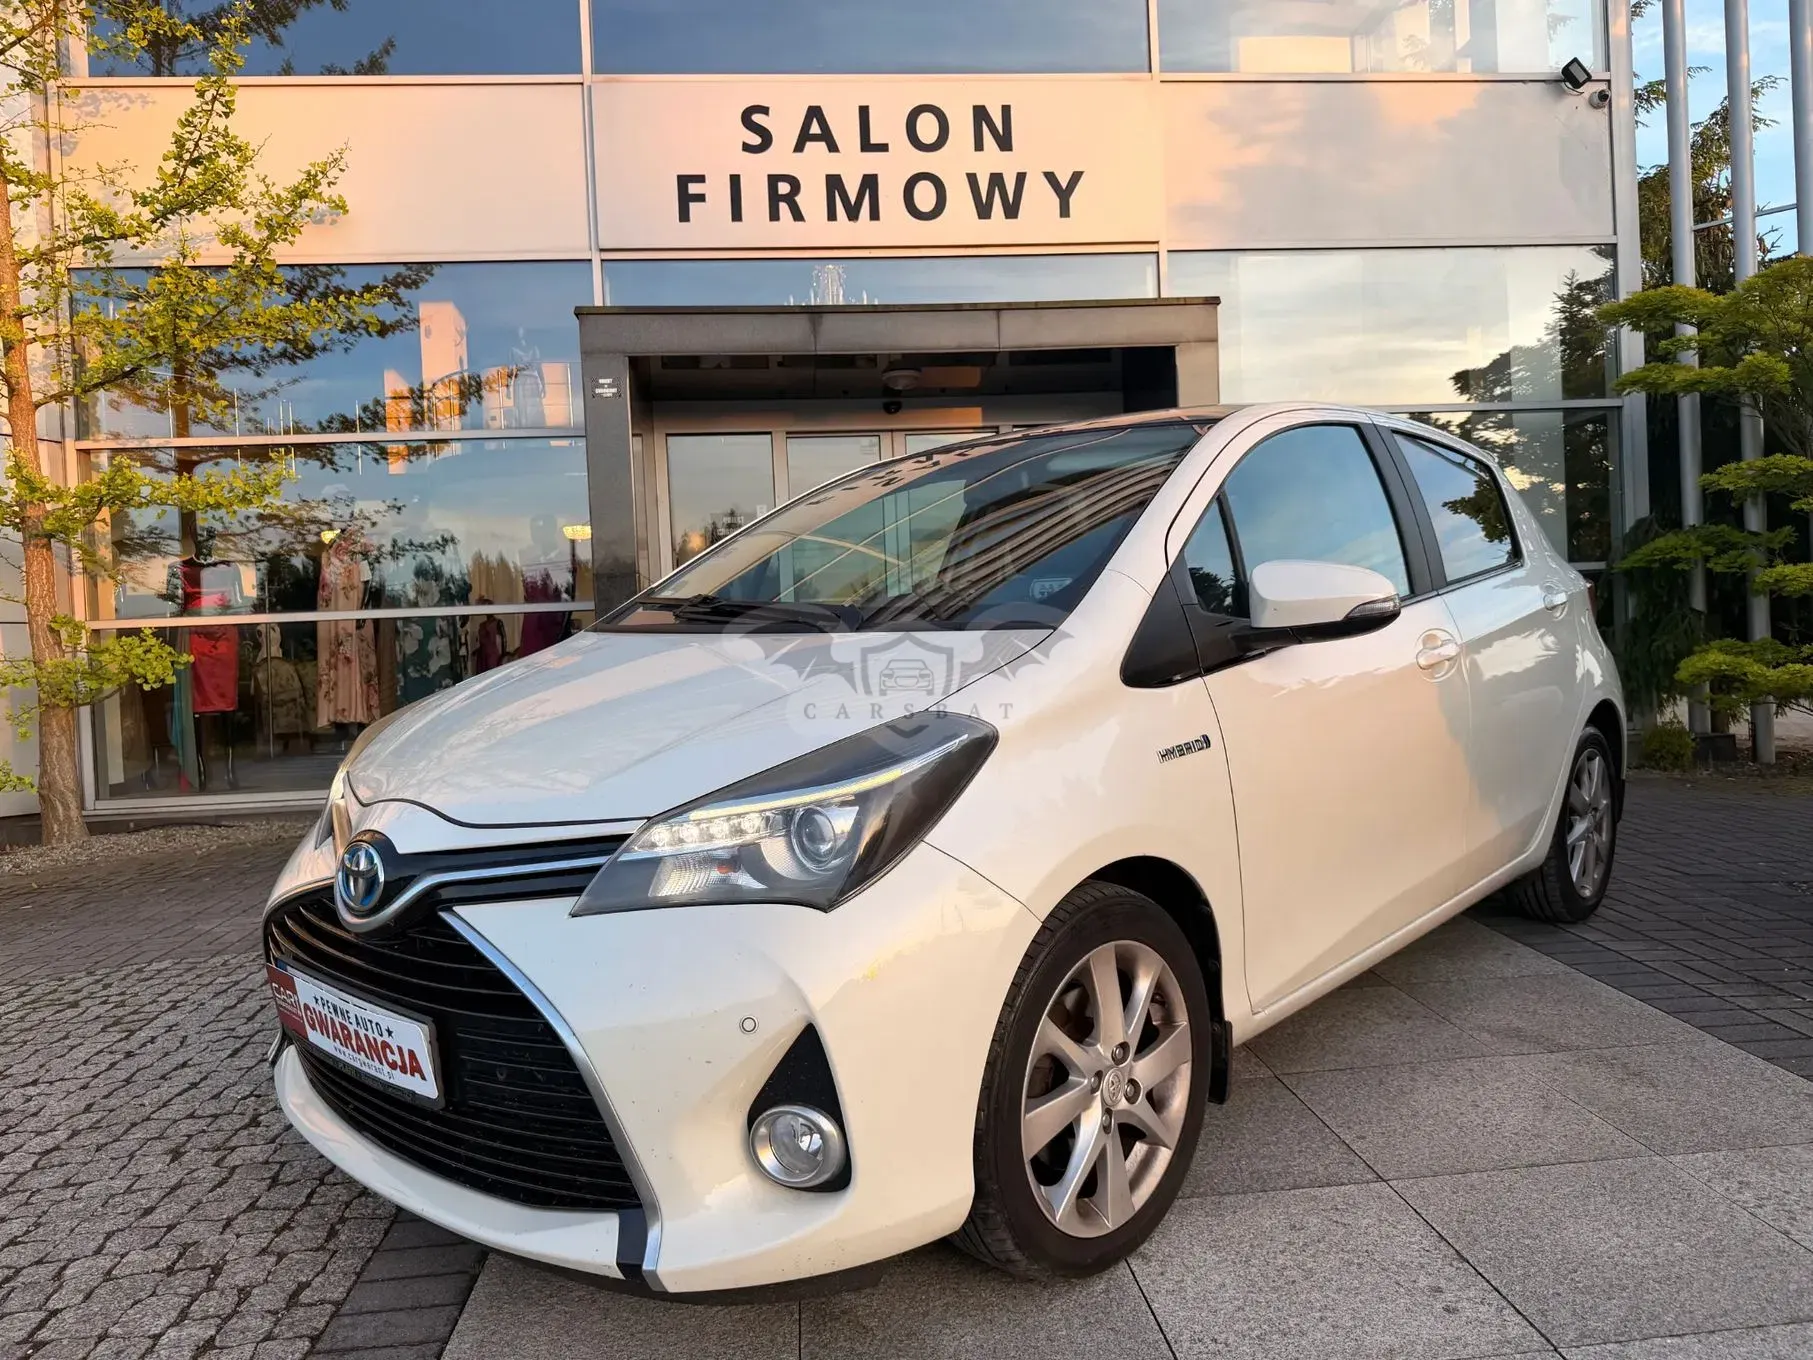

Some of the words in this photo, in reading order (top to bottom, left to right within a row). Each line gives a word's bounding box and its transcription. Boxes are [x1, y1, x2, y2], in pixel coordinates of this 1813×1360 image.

[740, 104, 1014, 154] SALON
[676, 171, 1085, 223] FIRMOWY
[1156, 738, 1205, 764] HYBRID
[303, 1002, 427, 1081] GWARANCJA
[320, 996, 353, 1026] PEWNE
[355, 1013, 384, 1037] AUTO
